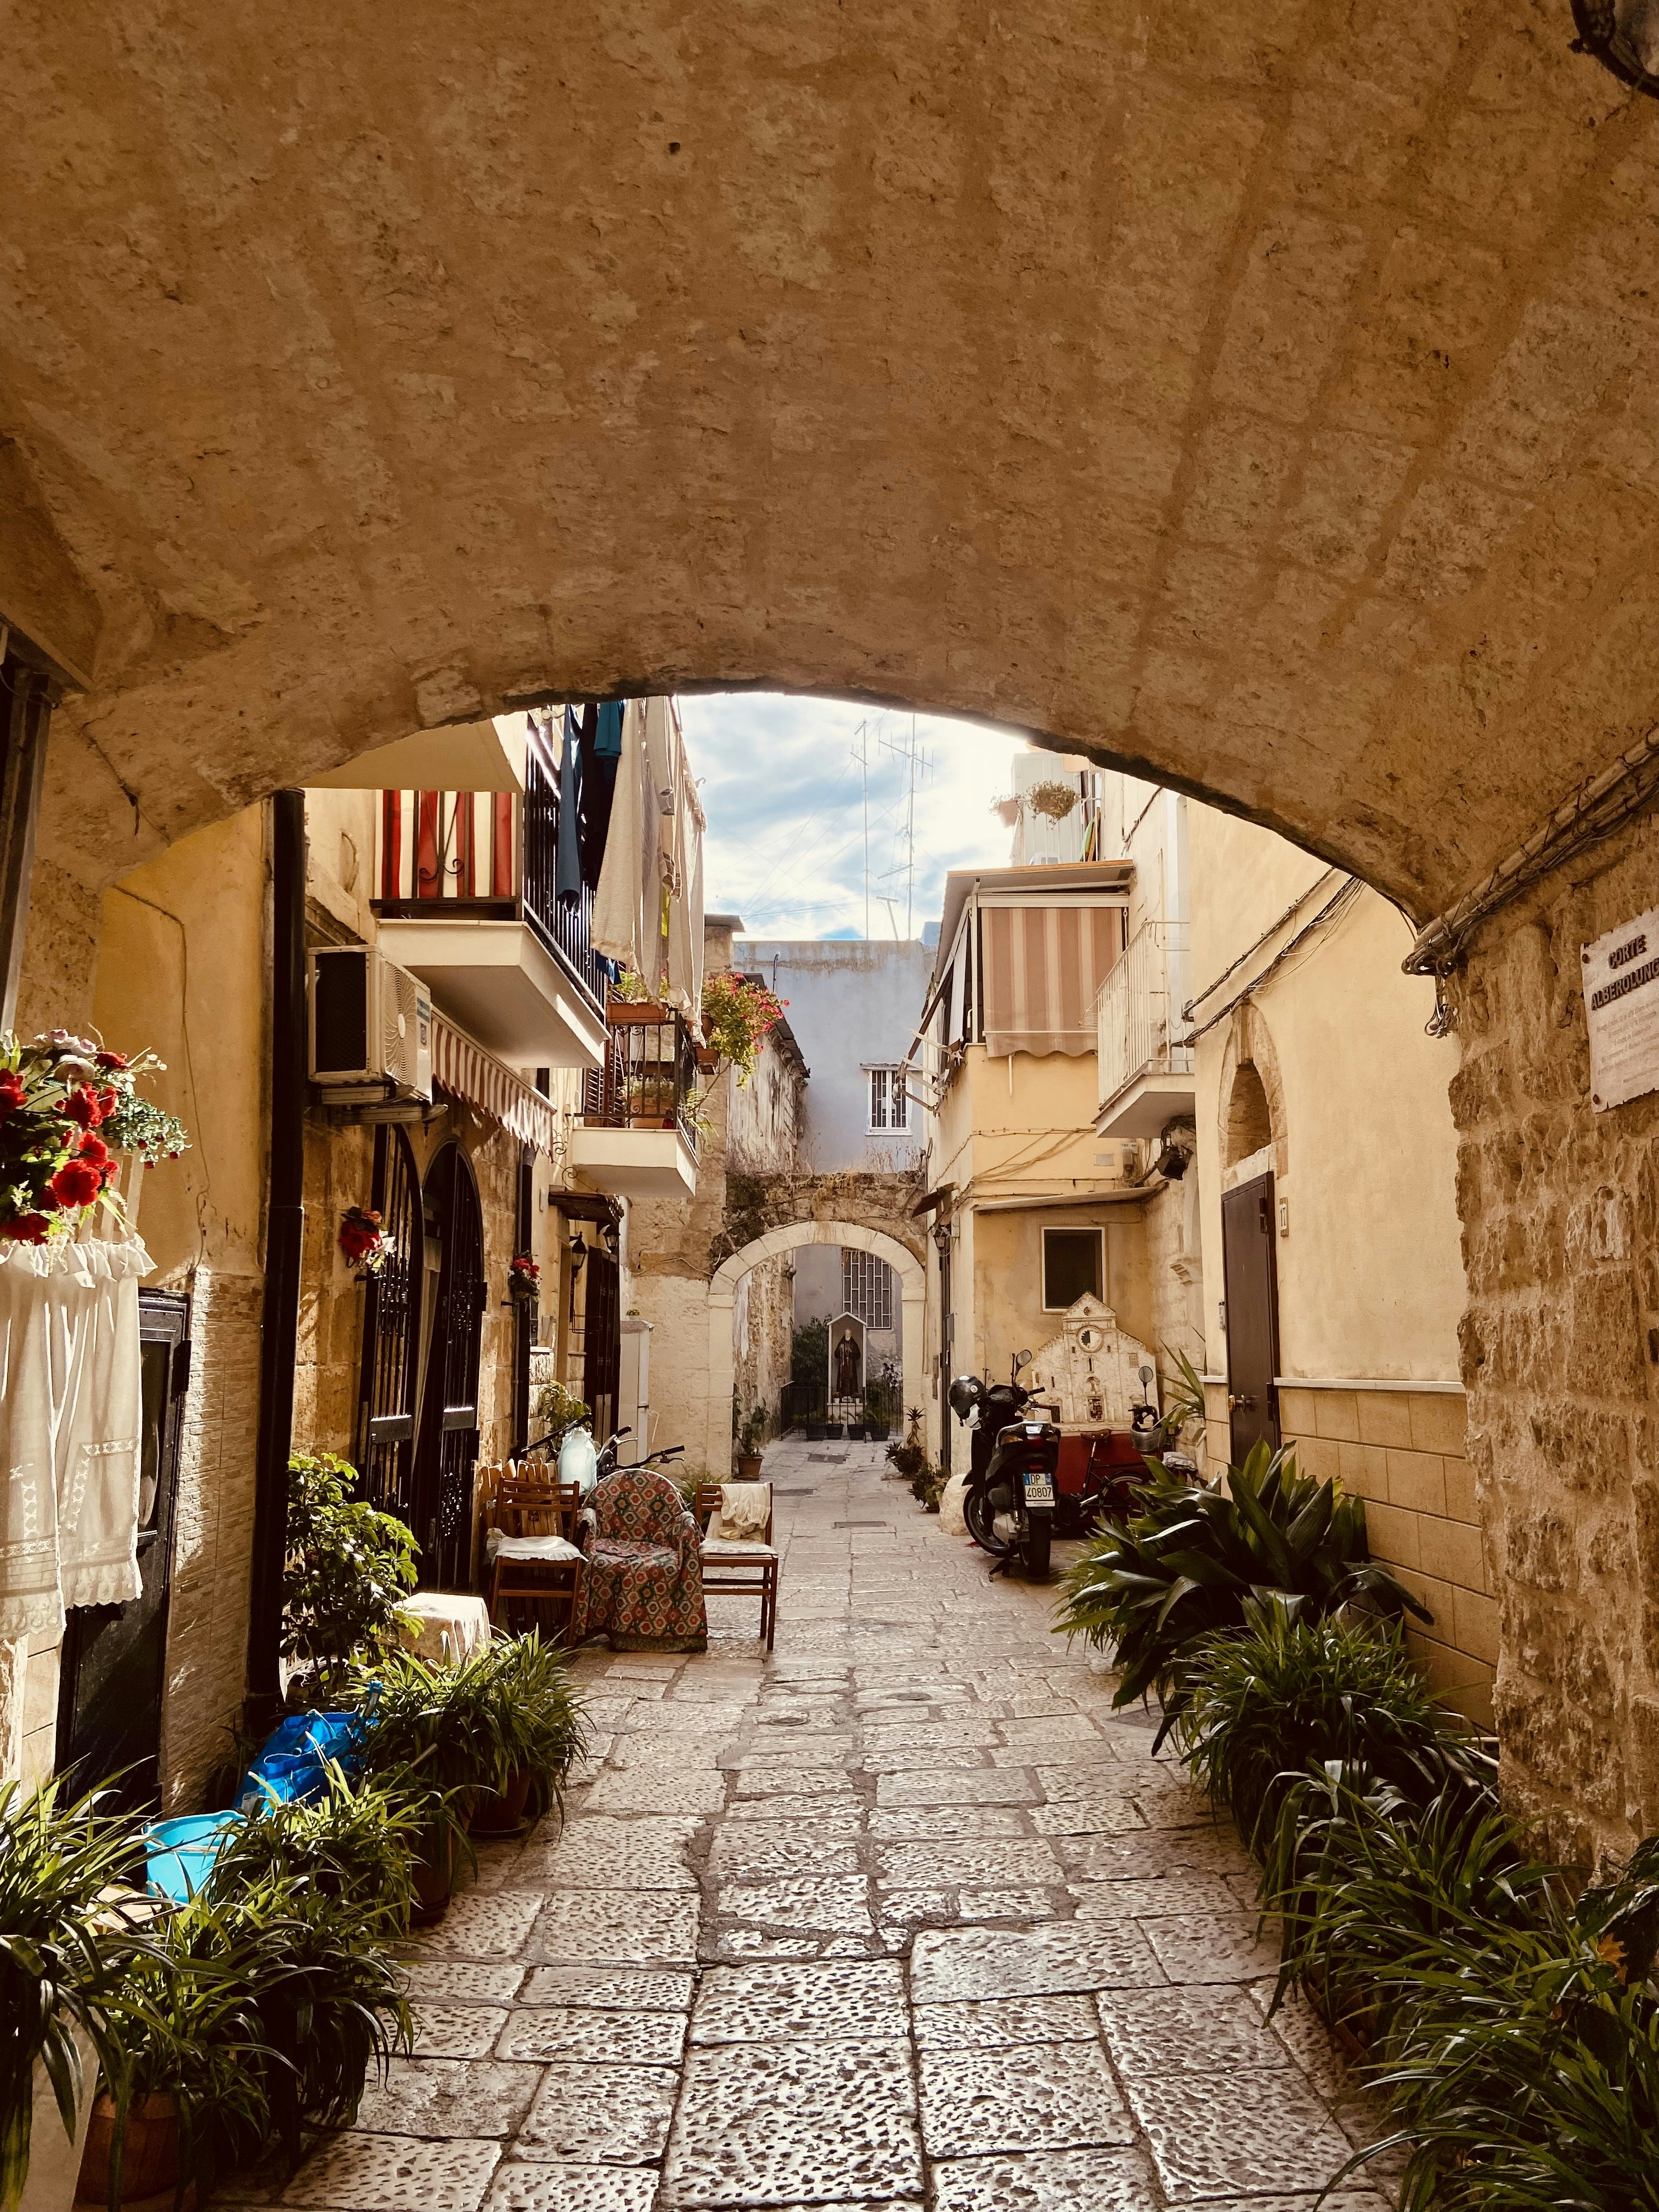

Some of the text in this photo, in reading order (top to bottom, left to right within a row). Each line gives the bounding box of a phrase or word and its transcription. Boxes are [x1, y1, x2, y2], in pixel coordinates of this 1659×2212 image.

[1608, 934, 1646, 969] CORTE
[1280, 1207, 1286, 1227] 17
[1030, 1474, 1040, 1485] DP
[1027, 1487, 1051, 1497] 40807
